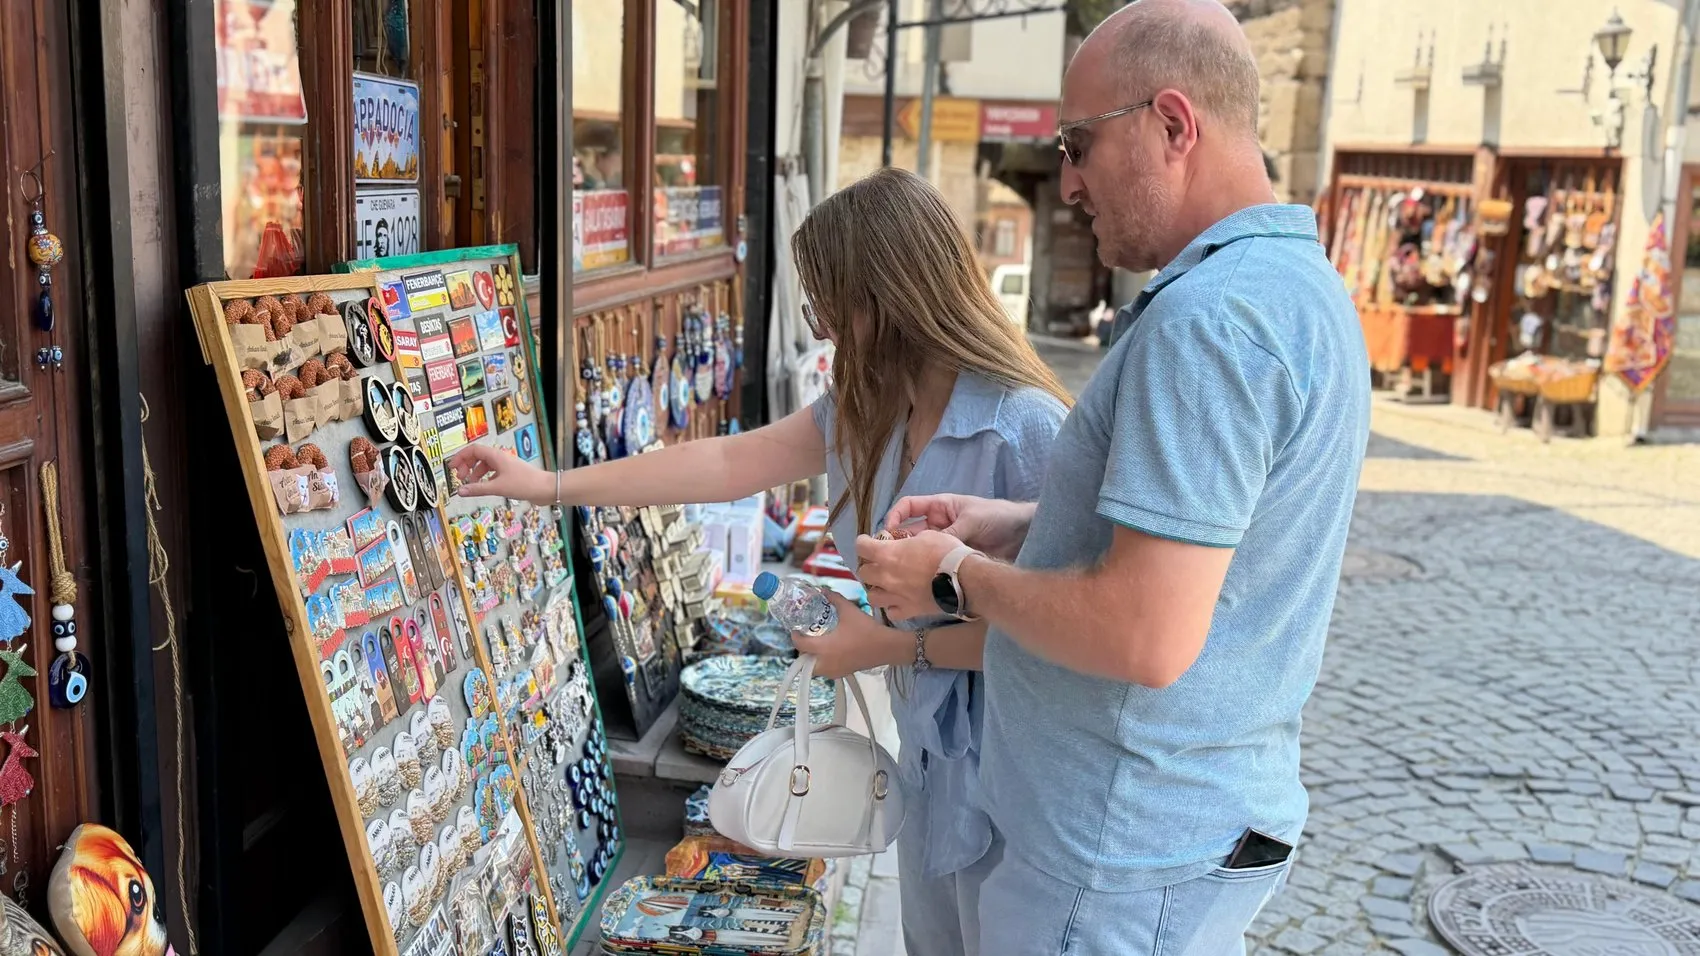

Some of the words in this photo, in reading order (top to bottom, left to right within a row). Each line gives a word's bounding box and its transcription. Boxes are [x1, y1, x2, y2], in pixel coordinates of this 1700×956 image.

[353, 97, 414, 146] APPADOCIA
[391, 215, 418, 256] 1928
[406, 273, 443, 290] FENERBAHÇE
[395, 334, 417, 347] SARAY
[408, 381, 422, 394] TAŞ
